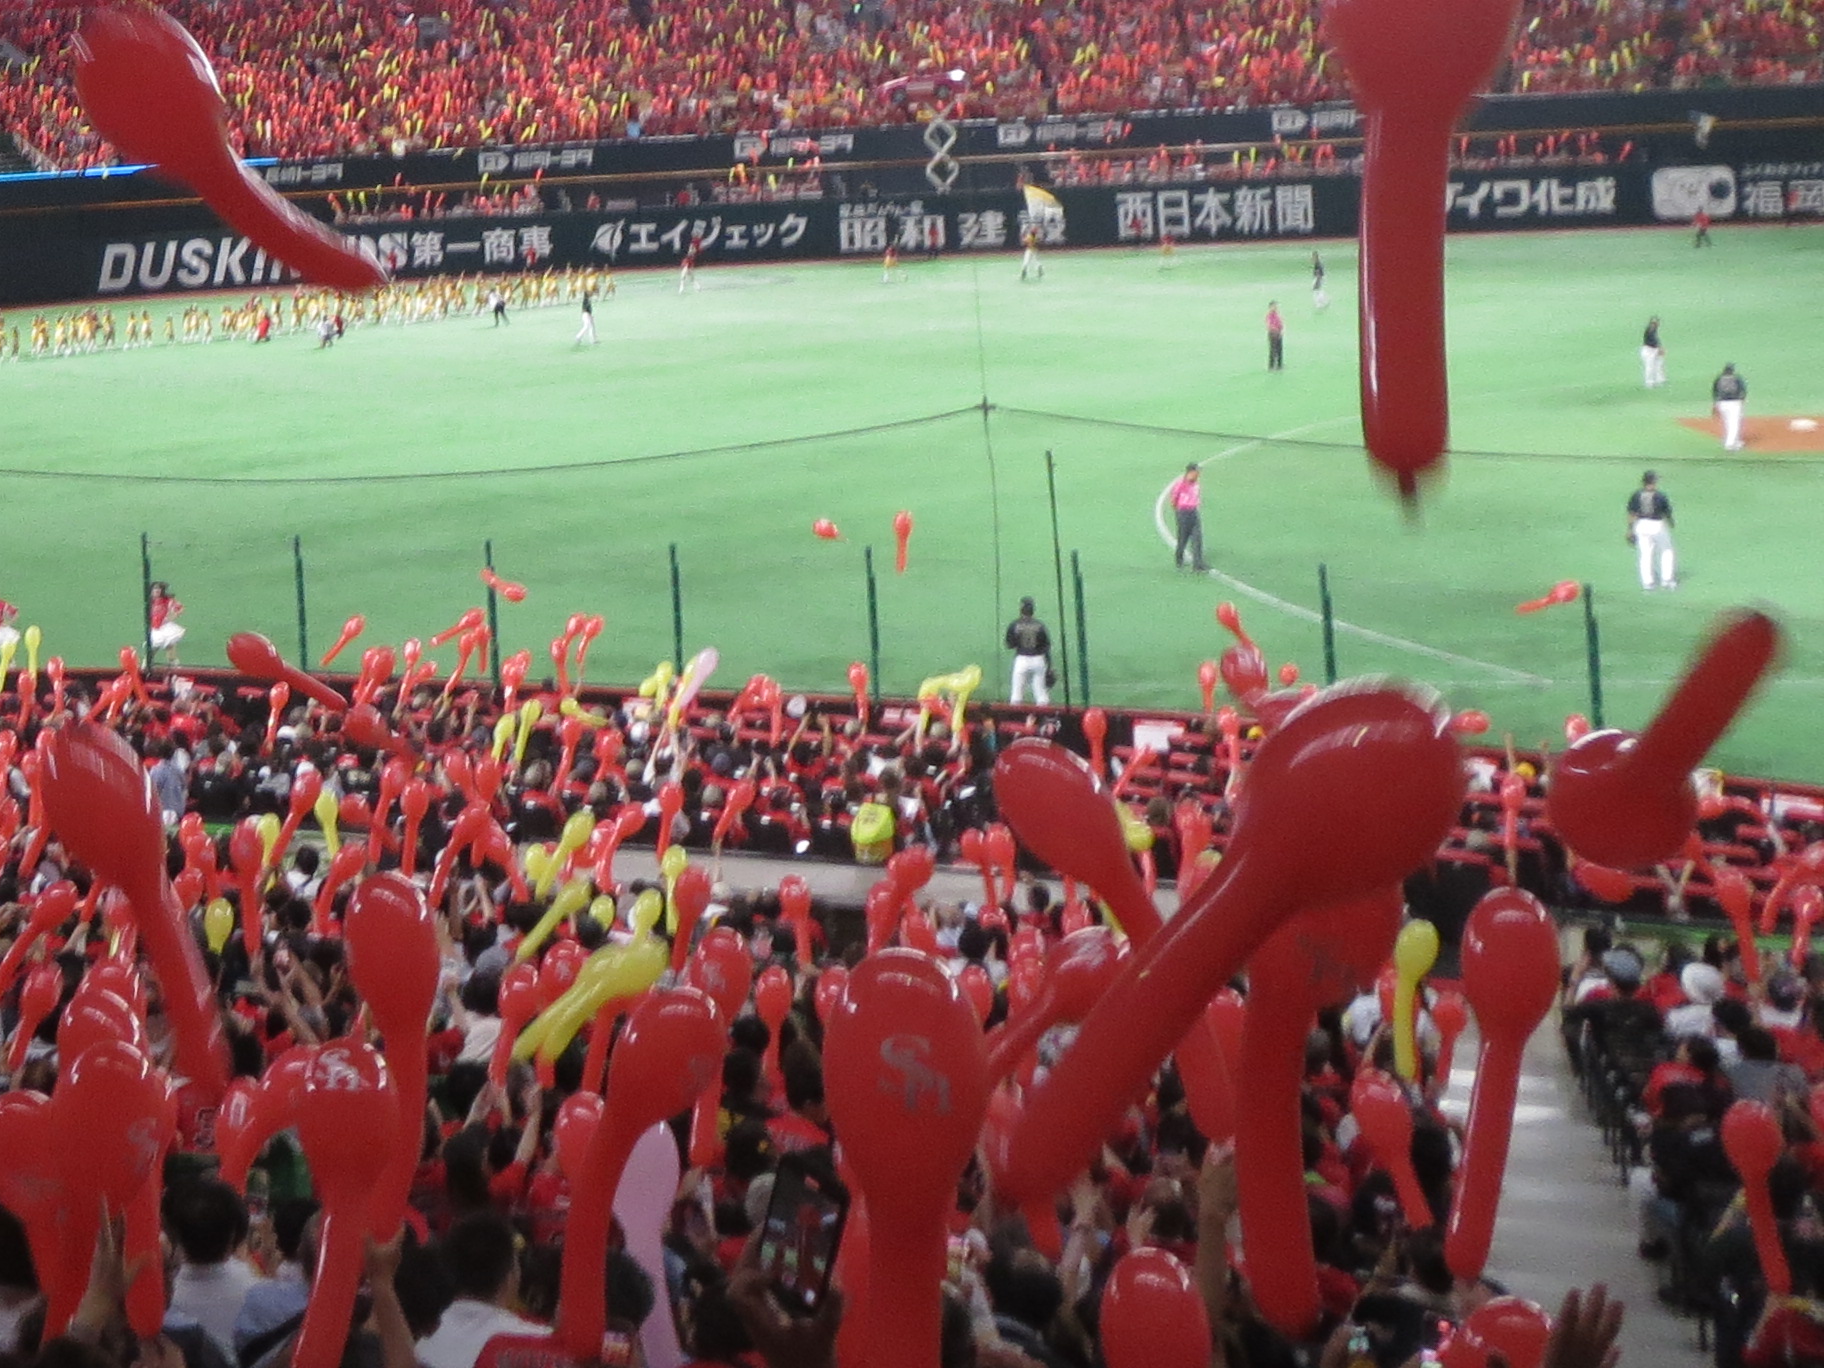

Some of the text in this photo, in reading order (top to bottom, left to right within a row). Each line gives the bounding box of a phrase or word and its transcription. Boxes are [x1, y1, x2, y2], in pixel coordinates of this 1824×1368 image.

[628, 212, 808, 252] エイジェック
[1116, 185, 1314, 241] 西日本新聞
[97, 236, 301, 292] DUSKI
